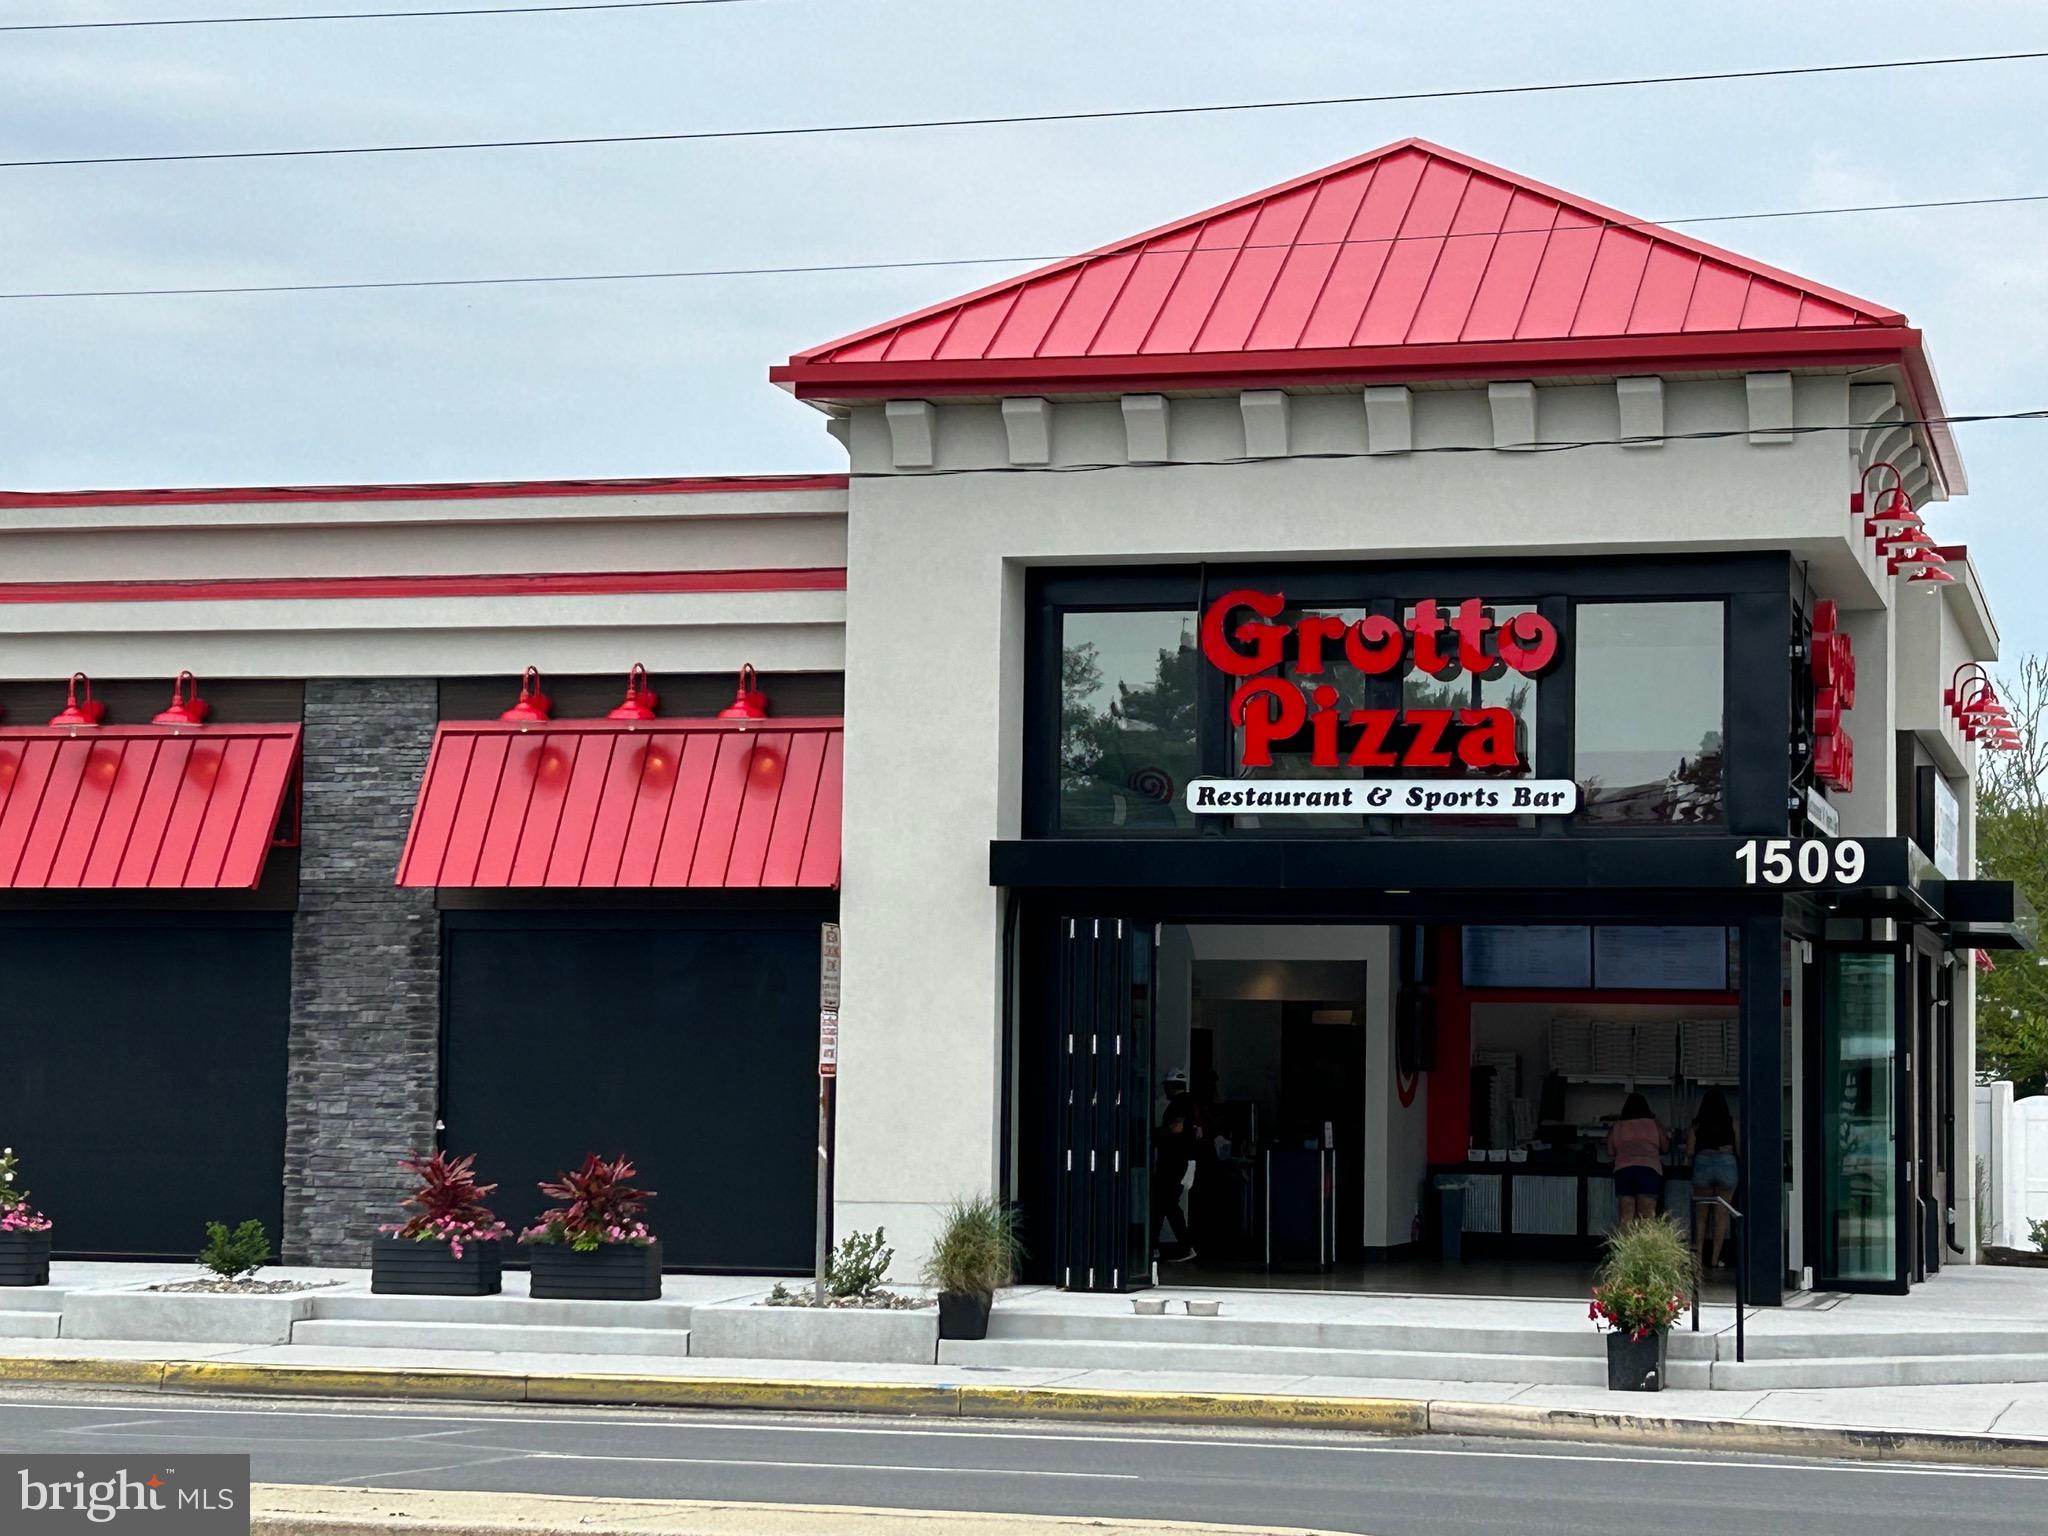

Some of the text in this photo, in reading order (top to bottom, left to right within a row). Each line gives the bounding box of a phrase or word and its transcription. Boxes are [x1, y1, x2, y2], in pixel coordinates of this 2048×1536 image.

[1201, 589, 1558, 676] Grotto
[1230, 676, 1520, 768] Pizza
[1196, 786, 1565, 812] Restaurant & Sports Bar
[1735, 840, 1865, 884] 1509
